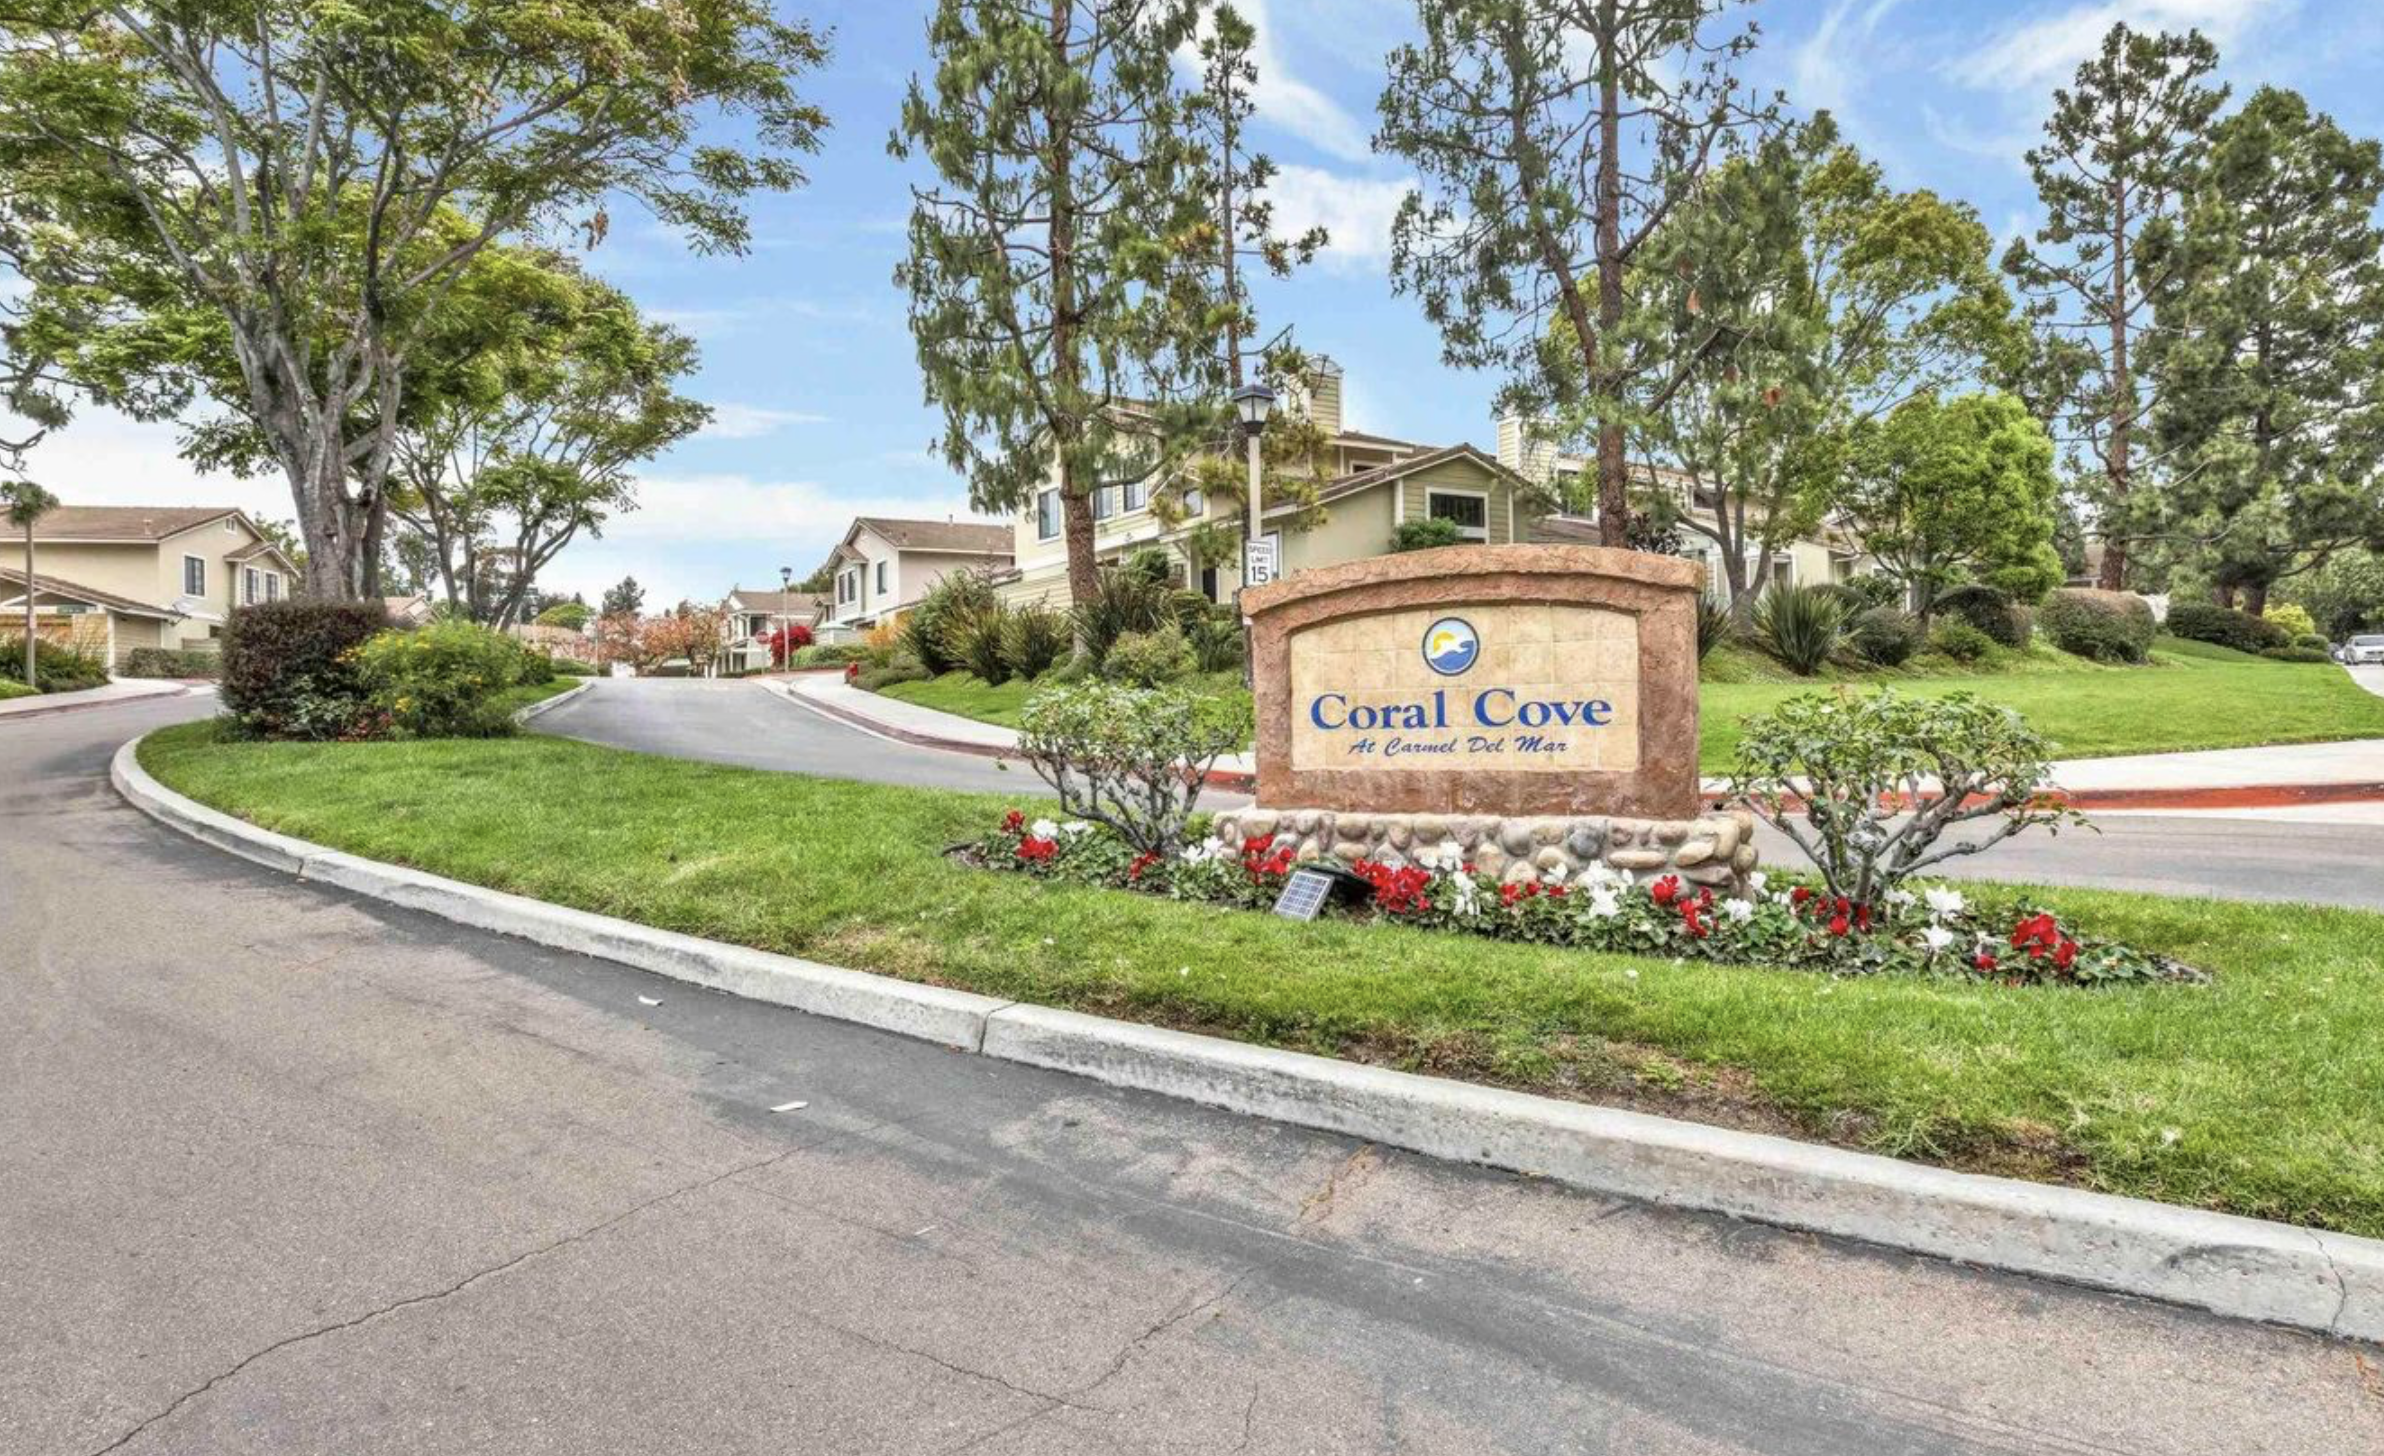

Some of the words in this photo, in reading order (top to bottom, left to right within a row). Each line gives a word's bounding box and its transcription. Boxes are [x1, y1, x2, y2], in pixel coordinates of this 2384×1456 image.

[1251, 565, 1269, 582] 15
[1310, 689, 1450, 730] Coral
[1473, 688, 1612, 728] Cove
[1348, 737, 1376, 755] At
[1384, 737, 1458, 757] Carmel
[1467, 735, 1505, 753] Del
[1515, 735, 1568, 753] Mar
